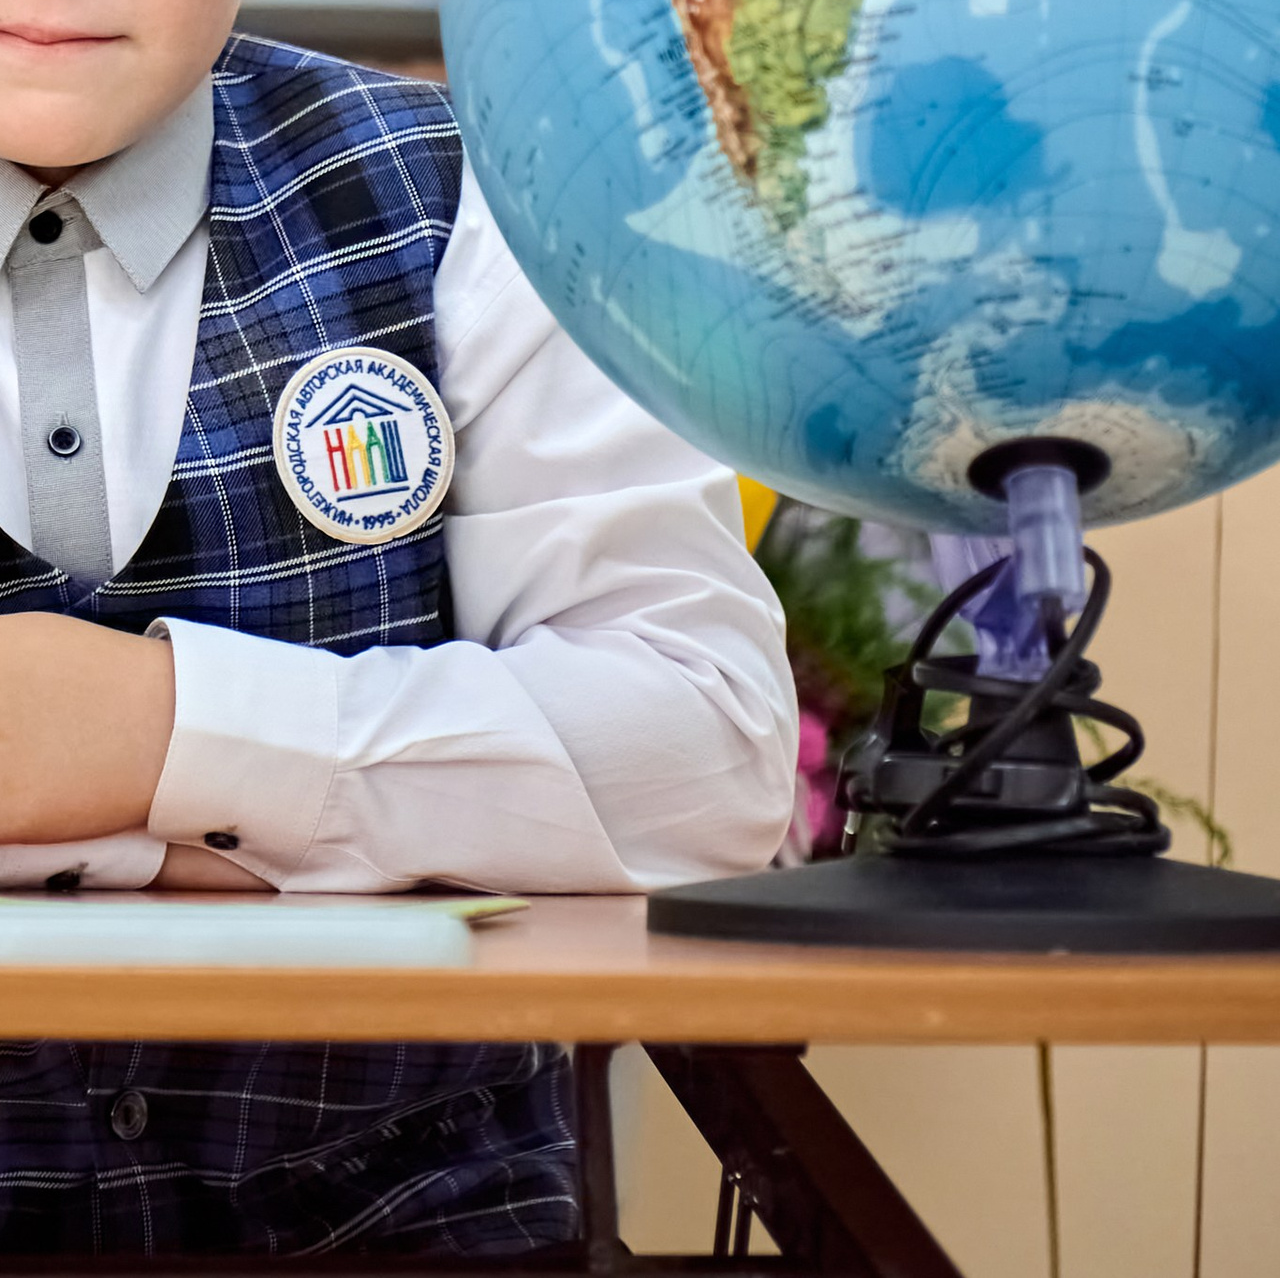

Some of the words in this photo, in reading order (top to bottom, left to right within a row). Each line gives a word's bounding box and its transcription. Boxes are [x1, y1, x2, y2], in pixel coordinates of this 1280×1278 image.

[297, 359, 364, 409] АВТОРСКАЯ
[367, 361, 442, 466] АКАДЕМИЧЕСКАЯ
[285, 409, 354, 527] НИЖЕГОРОДСКАЯ
[323, 420, 409, 492] НААШ
[363, 510, 396, 530] 1995
[401, 467, 439, 516] ШКОЛА
